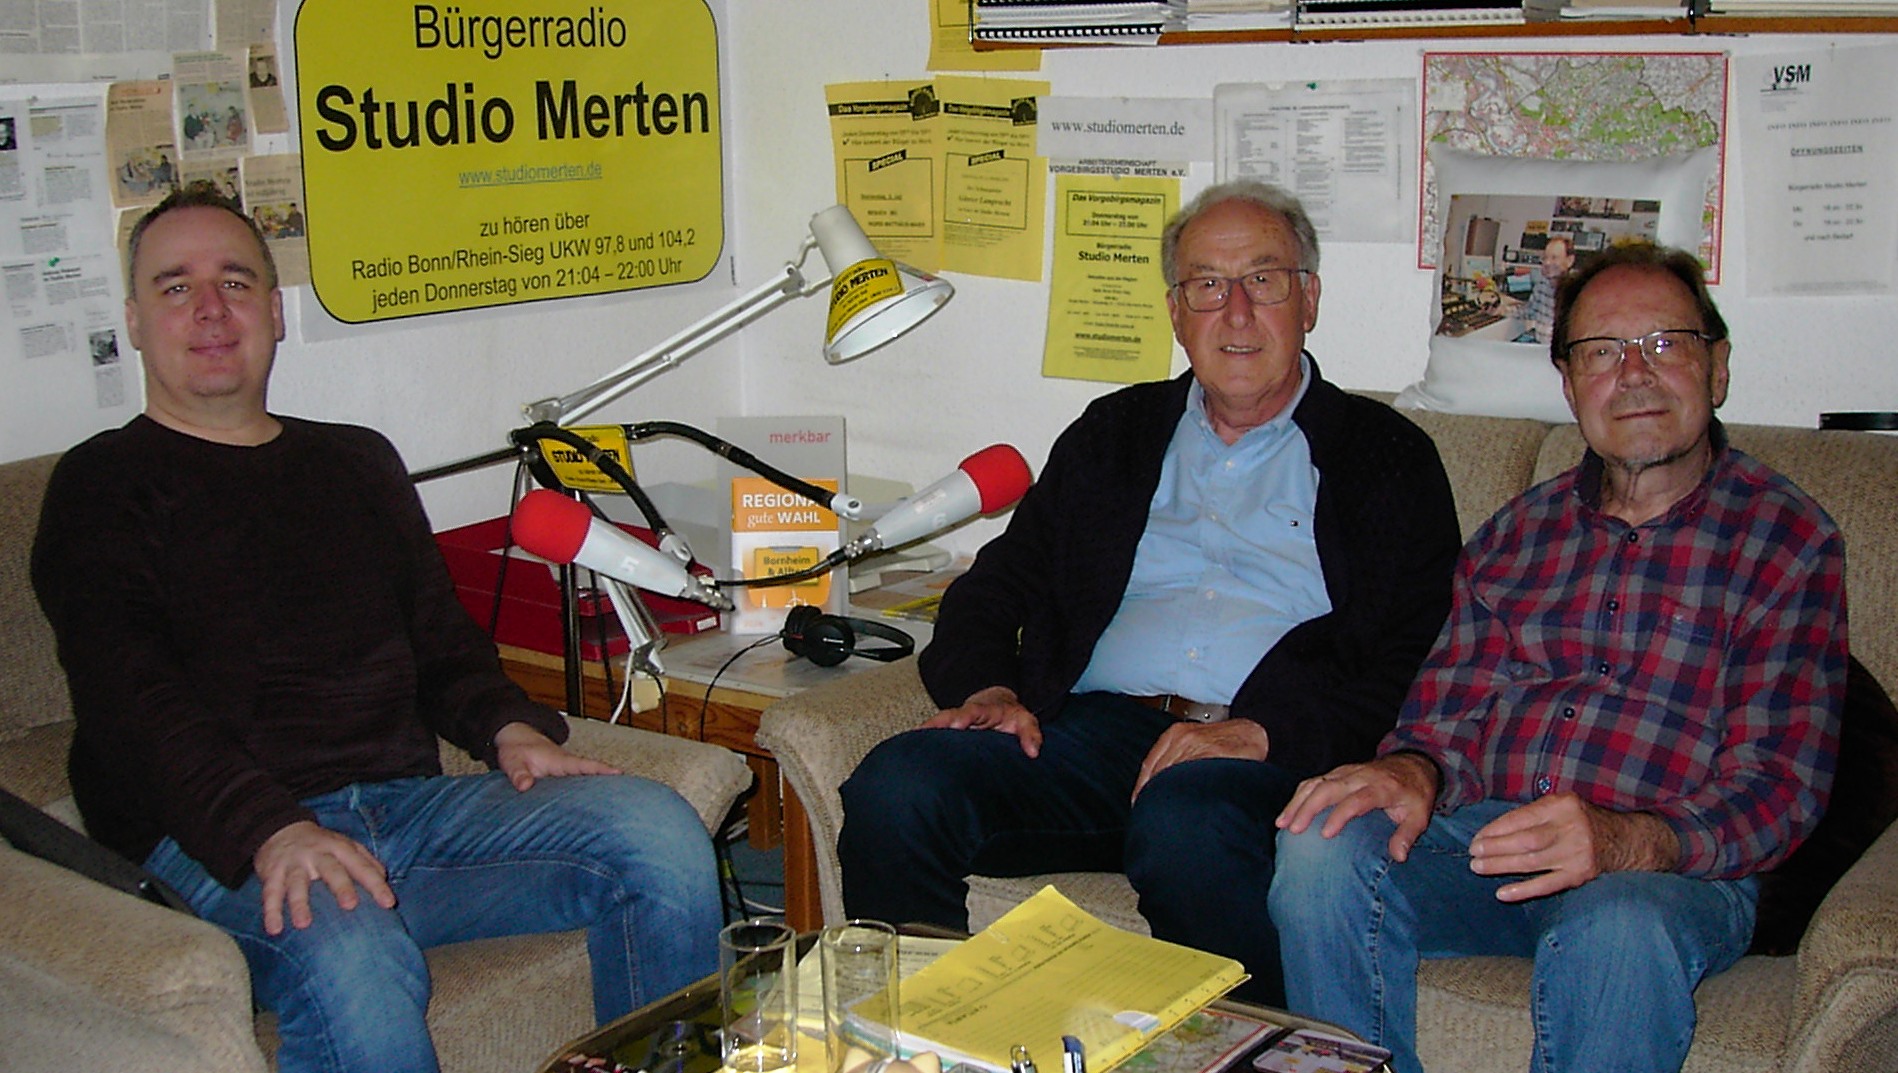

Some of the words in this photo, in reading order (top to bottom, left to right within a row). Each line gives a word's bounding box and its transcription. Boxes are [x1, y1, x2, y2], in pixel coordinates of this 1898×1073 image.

[414, 4, 627, 59] Bürgerradio
[1773, 64, 1811, 83] VSM
[316, 82, 515, 152] Studio
[535, 79, 710, 141] Merten
[1052, 120, 1185, 136] www.studiomerten.de
[459, 161, 603, 188] www.studiomerten.de
[1048, 165, 1131, 175] VORGEBIRGSSTUDIO
[1134, 167, 1168, 176] MERTEN
[1072, 193, 1087, 202] Das
[1088, 194, 1162, 206] Vorgebirgsmagazin
[480, 221, 499, 238] zu
[503, 214, 550, 236] hören
[555, 212, 590, 232] über
[353, 256, 403, 281] Radio
[408, 243, 545, 274] Bonn/Rhein-Sieg
[550, 239, 591, 260] UKW
[595, 234, 626, 257] 97,8
[629, 232, 655, 253] und
[659, 228, 696, 249] 104,2
[1078, 250, 1111, 262] Studio
[1113, 252, 1150, 265] Merten
[371, 288, 420, 313] jeden
[425, 276, 517, 304] Donnerstag
[522, 273, 551, 293] von
[556, 268, 601, 290] 21:04
[617, 261, 655, 281] 22:00
[659, 258, 683, 276] Uhr
[849, 267, 889, 289] MERTEN
[769, 430, 831, 444] merkbar
[742, 493, 820, 508] REGIONA
[747, 511, 774, 529] gute
[777, 511, 822, 524] WAHL
[763, 556, 811, 565] Bornheim
